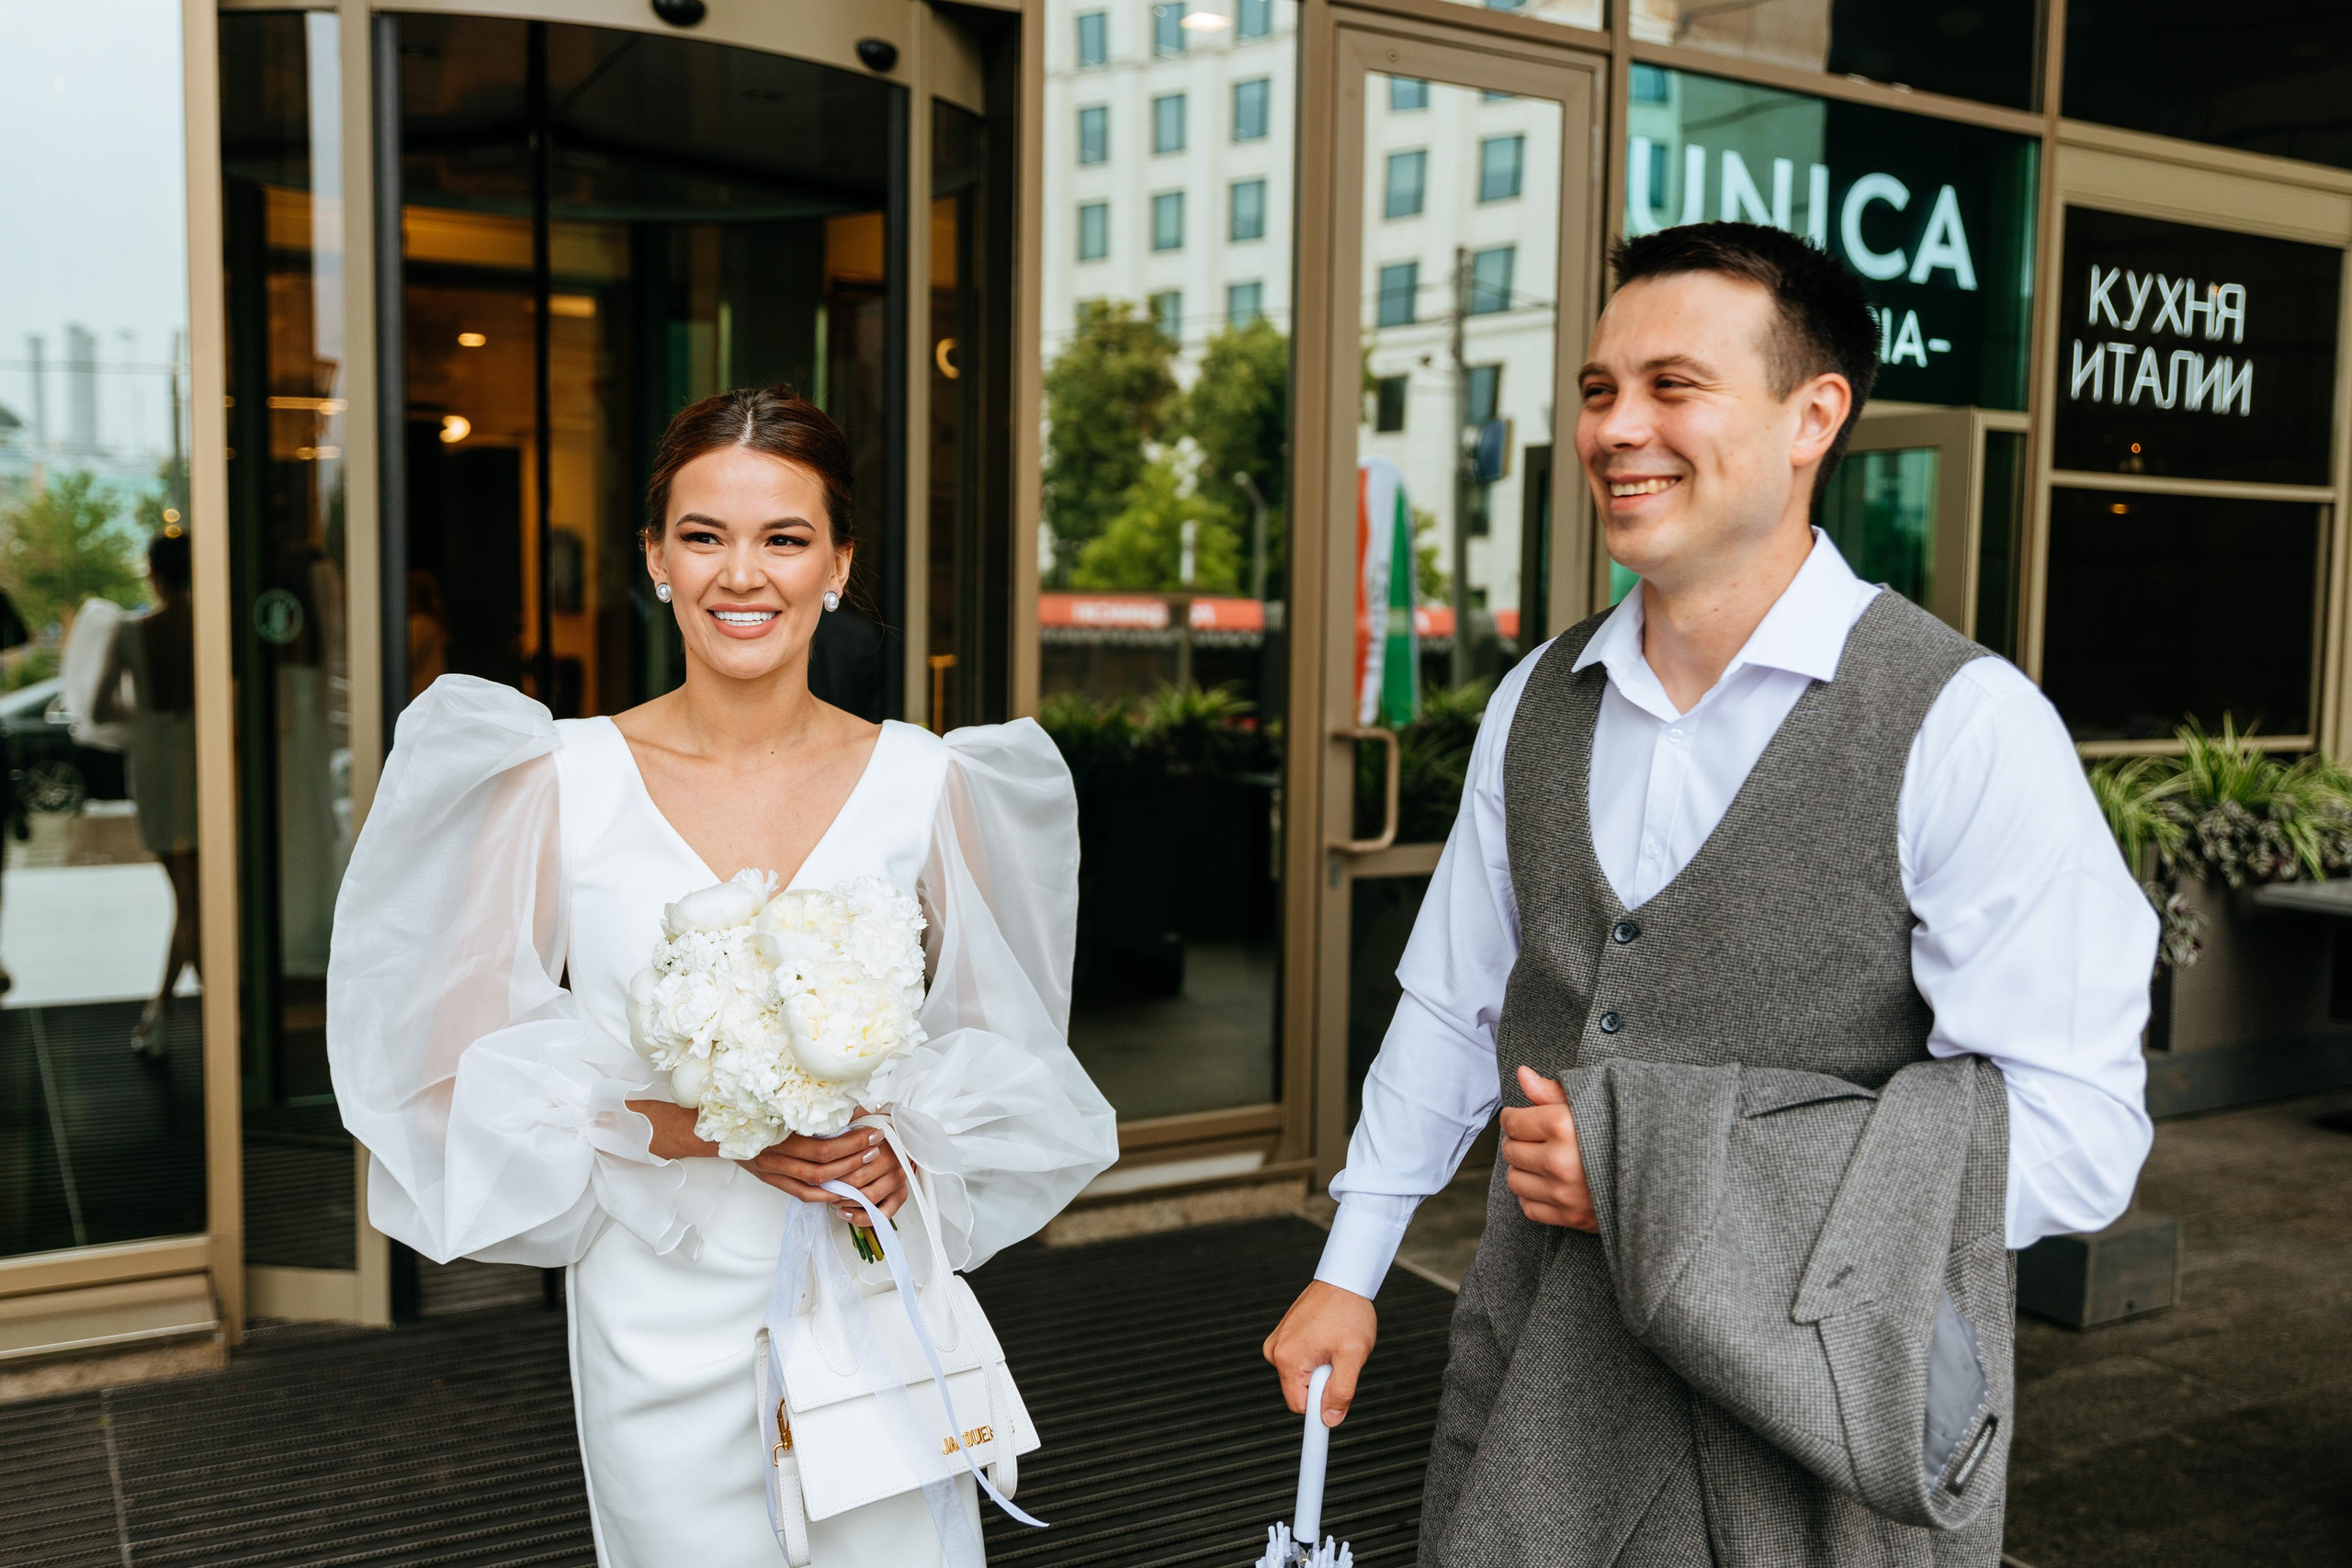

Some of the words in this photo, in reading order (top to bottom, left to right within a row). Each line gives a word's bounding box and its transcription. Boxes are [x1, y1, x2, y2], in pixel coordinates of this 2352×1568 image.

[1628, 135, 1978, 291] UNICA
[2088, 264, 2246, 344] КУХНЯ
[2070, 338, 2254, 416] ИТАЛИИ
